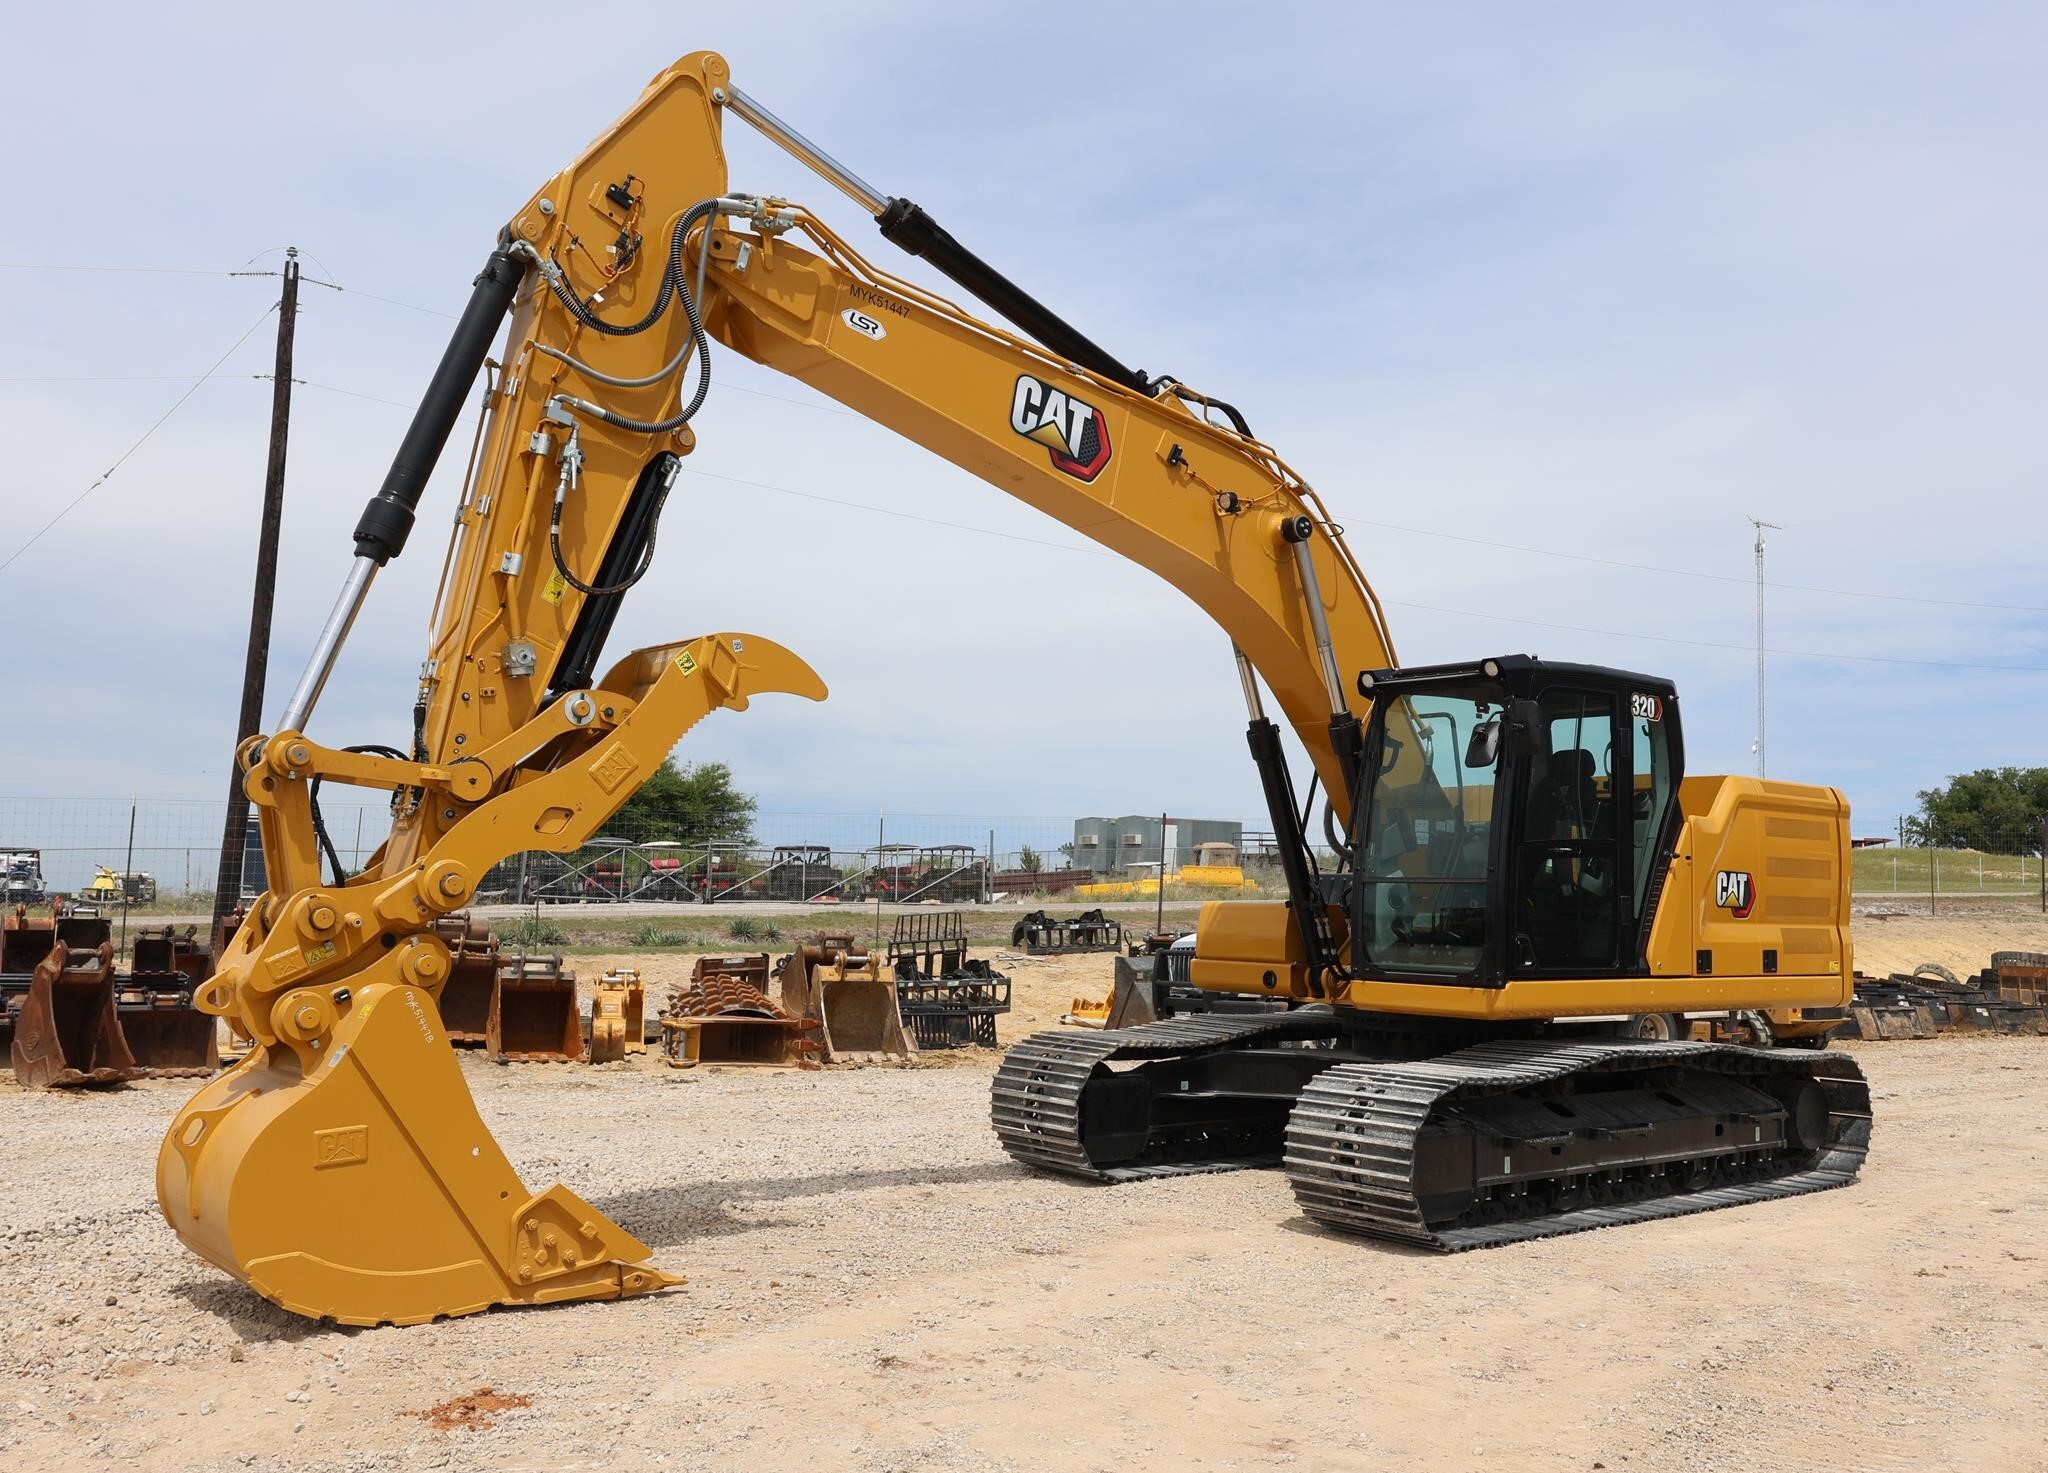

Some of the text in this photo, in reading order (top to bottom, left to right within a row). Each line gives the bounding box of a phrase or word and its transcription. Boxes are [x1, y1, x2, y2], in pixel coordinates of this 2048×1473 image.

[850, 284, 910, 318] MYK51447
[850, 311, 879, 335] LSR
[1012, 376, 1093, 458] CAT
[1632, 694, 1655, 718] 320
[1717, 871, 1748, 907] CAT
